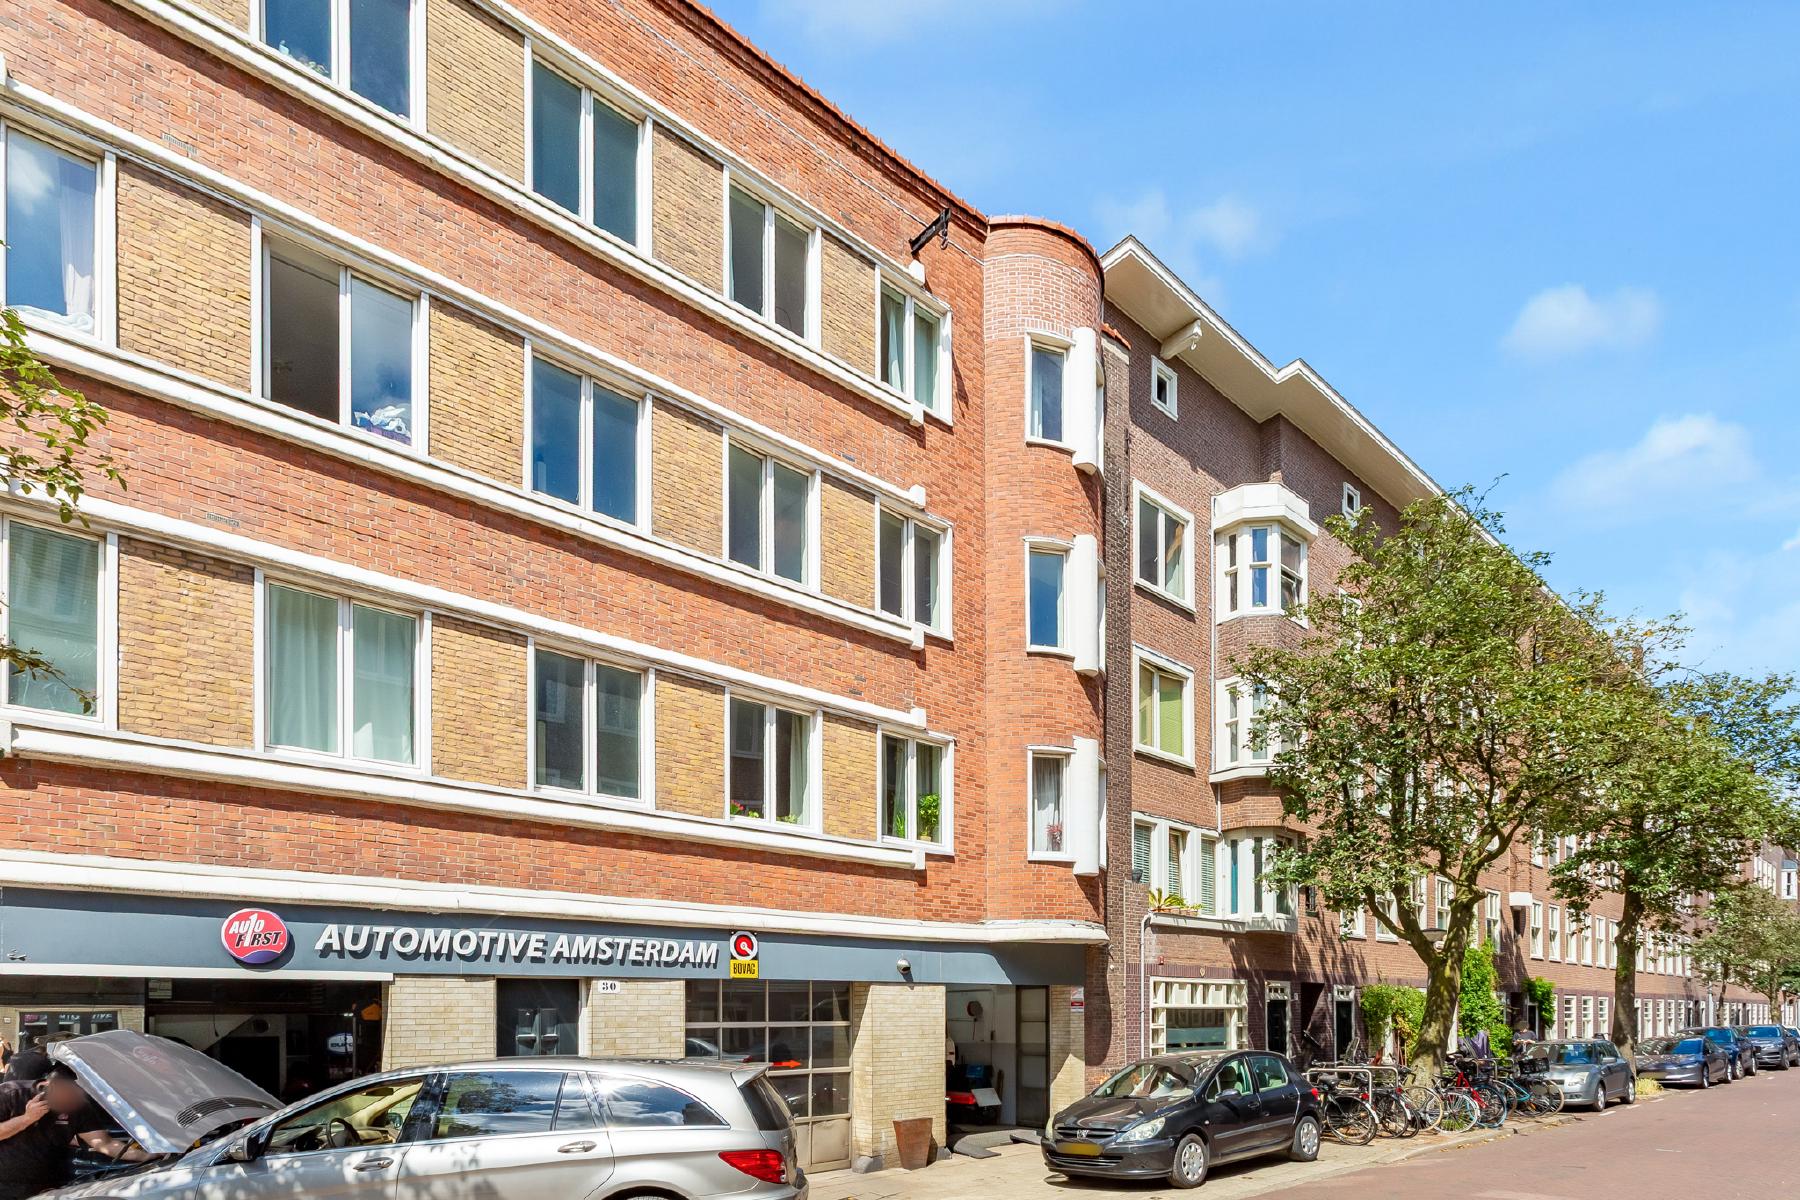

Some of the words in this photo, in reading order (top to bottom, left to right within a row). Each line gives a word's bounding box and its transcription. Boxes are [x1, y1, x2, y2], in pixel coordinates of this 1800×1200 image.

[314, 924, 546, 957] AUTOMOTIVE
[550, 935, 718, 964] AMSTERDAM
[733, 963, 755, 974] BOVAG
[602, 982, 616, 991] 30
